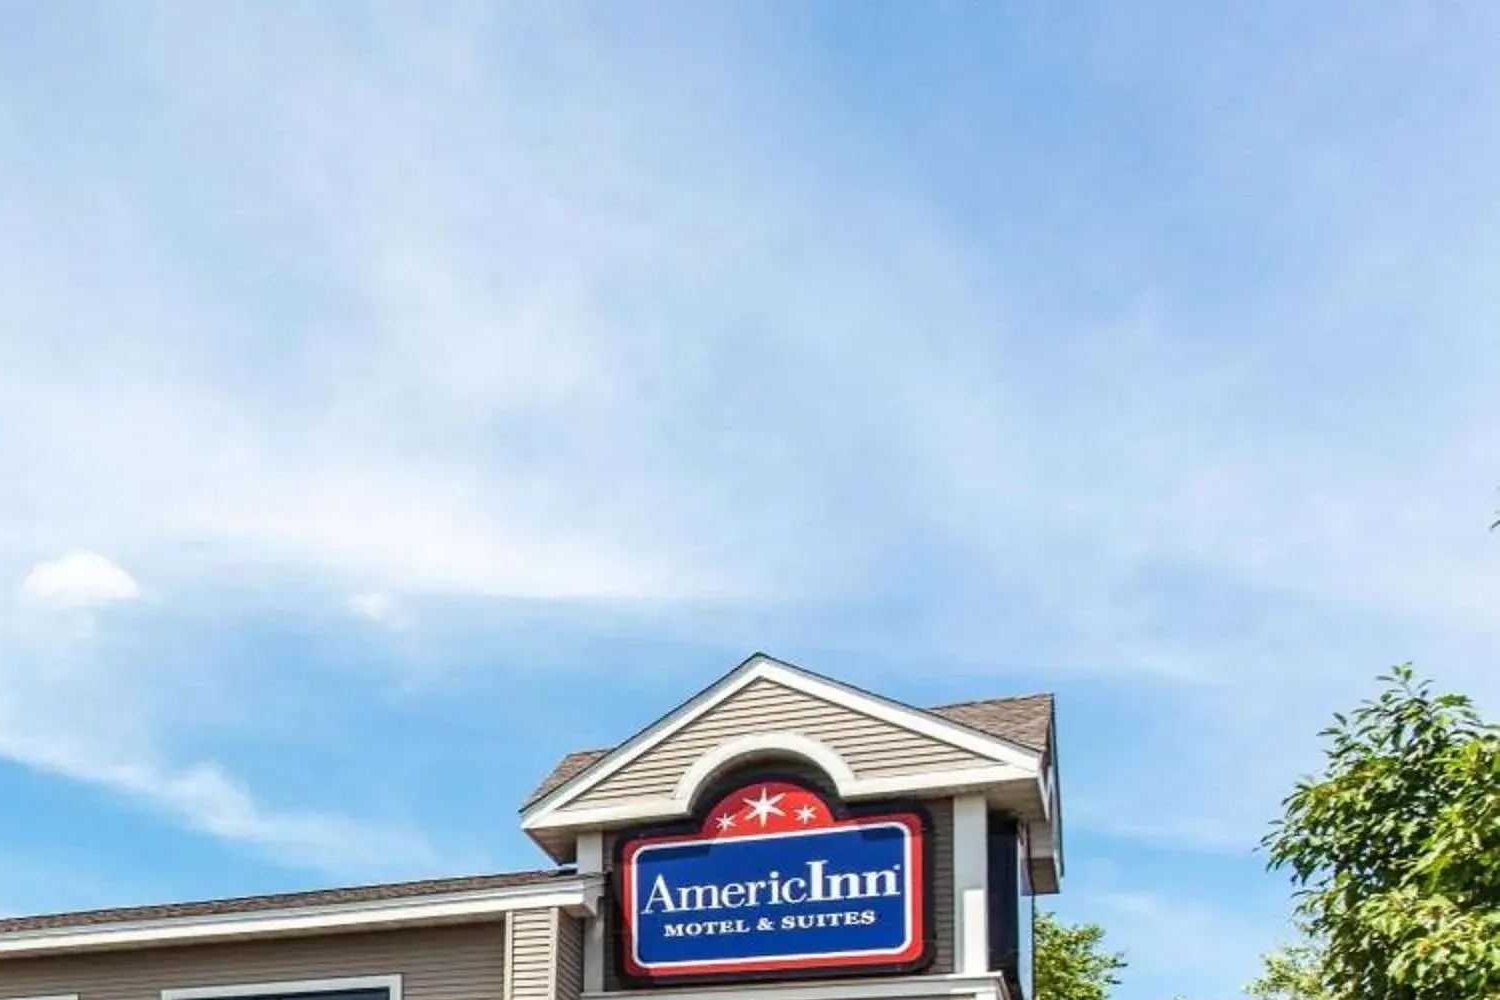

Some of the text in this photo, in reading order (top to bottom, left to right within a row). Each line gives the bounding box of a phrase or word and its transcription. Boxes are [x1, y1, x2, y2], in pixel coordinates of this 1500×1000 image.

[640, 859, 901, 915] AmericInn
[664, 909, 876, 937] MOTEL & SUITES
